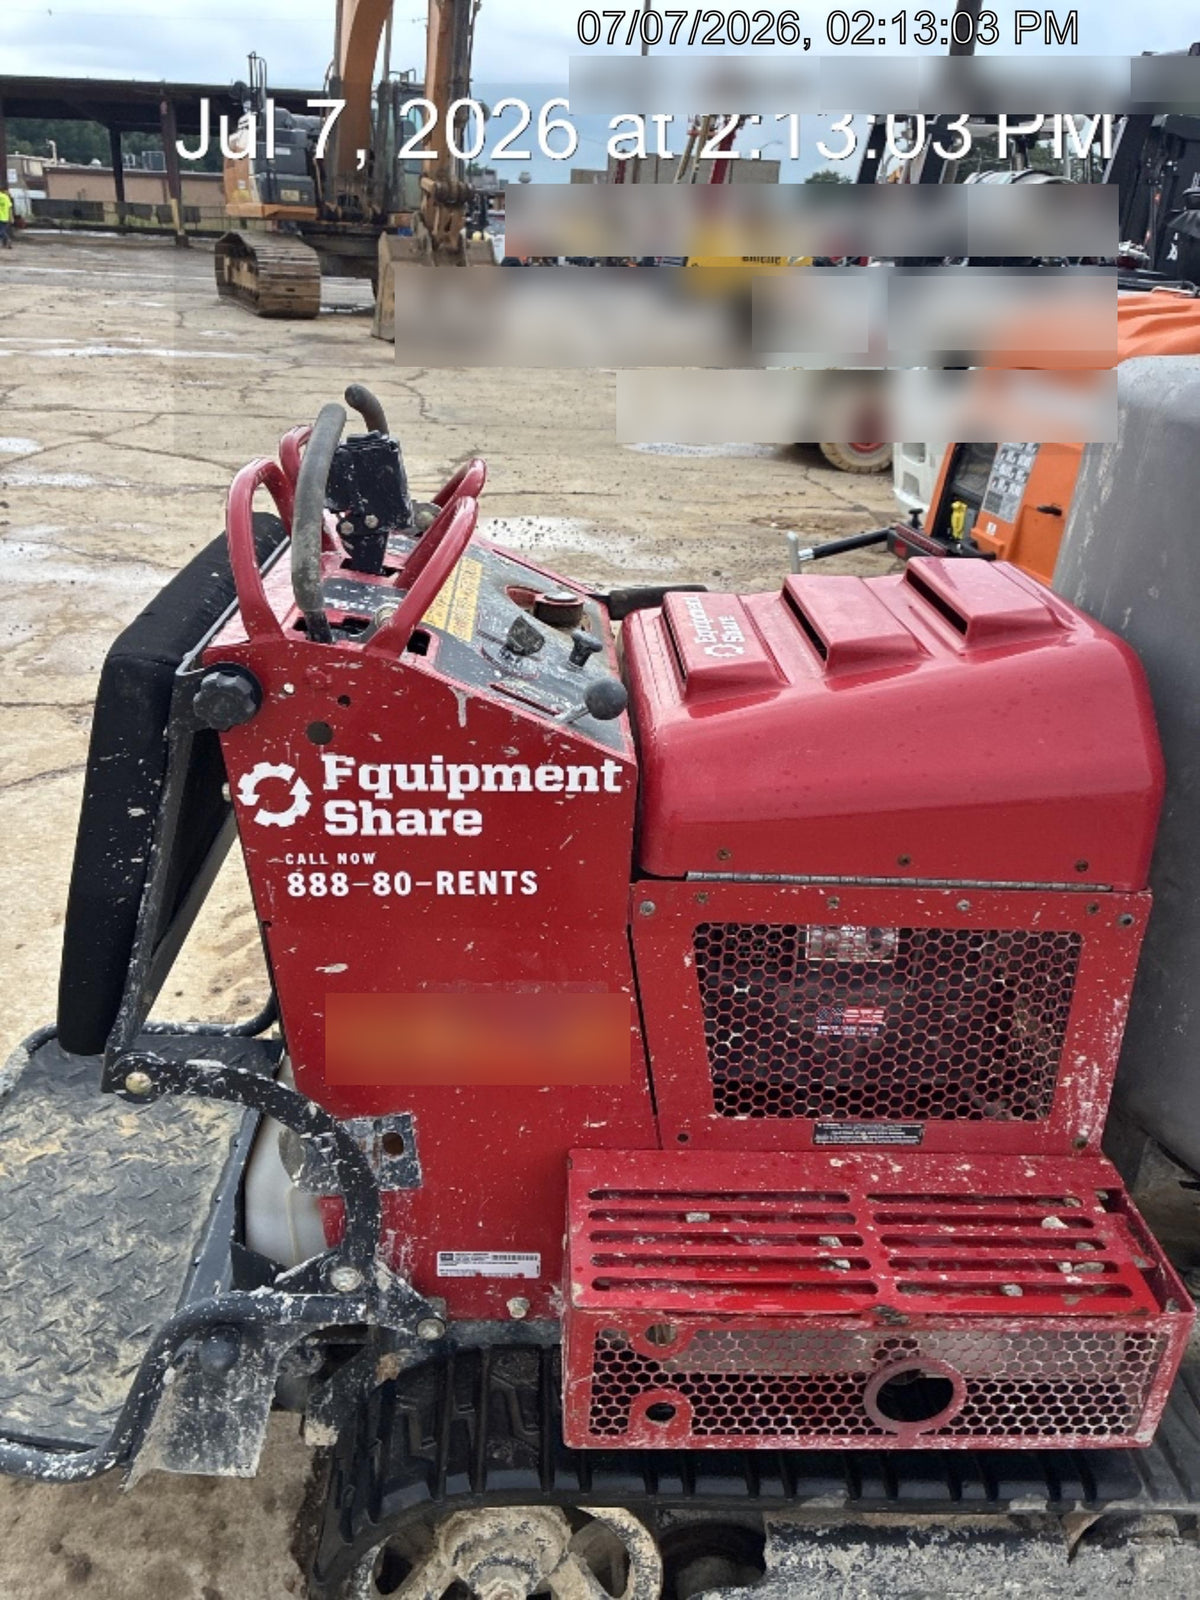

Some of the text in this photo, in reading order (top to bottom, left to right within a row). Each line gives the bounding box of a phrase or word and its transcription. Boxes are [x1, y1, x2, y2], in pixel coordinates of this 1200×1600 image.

[323, 800, 483, 836] Share
[285, 852, 377, 866] CALL NOW
[286, 869, 538, 897] 888-80-RENTS
